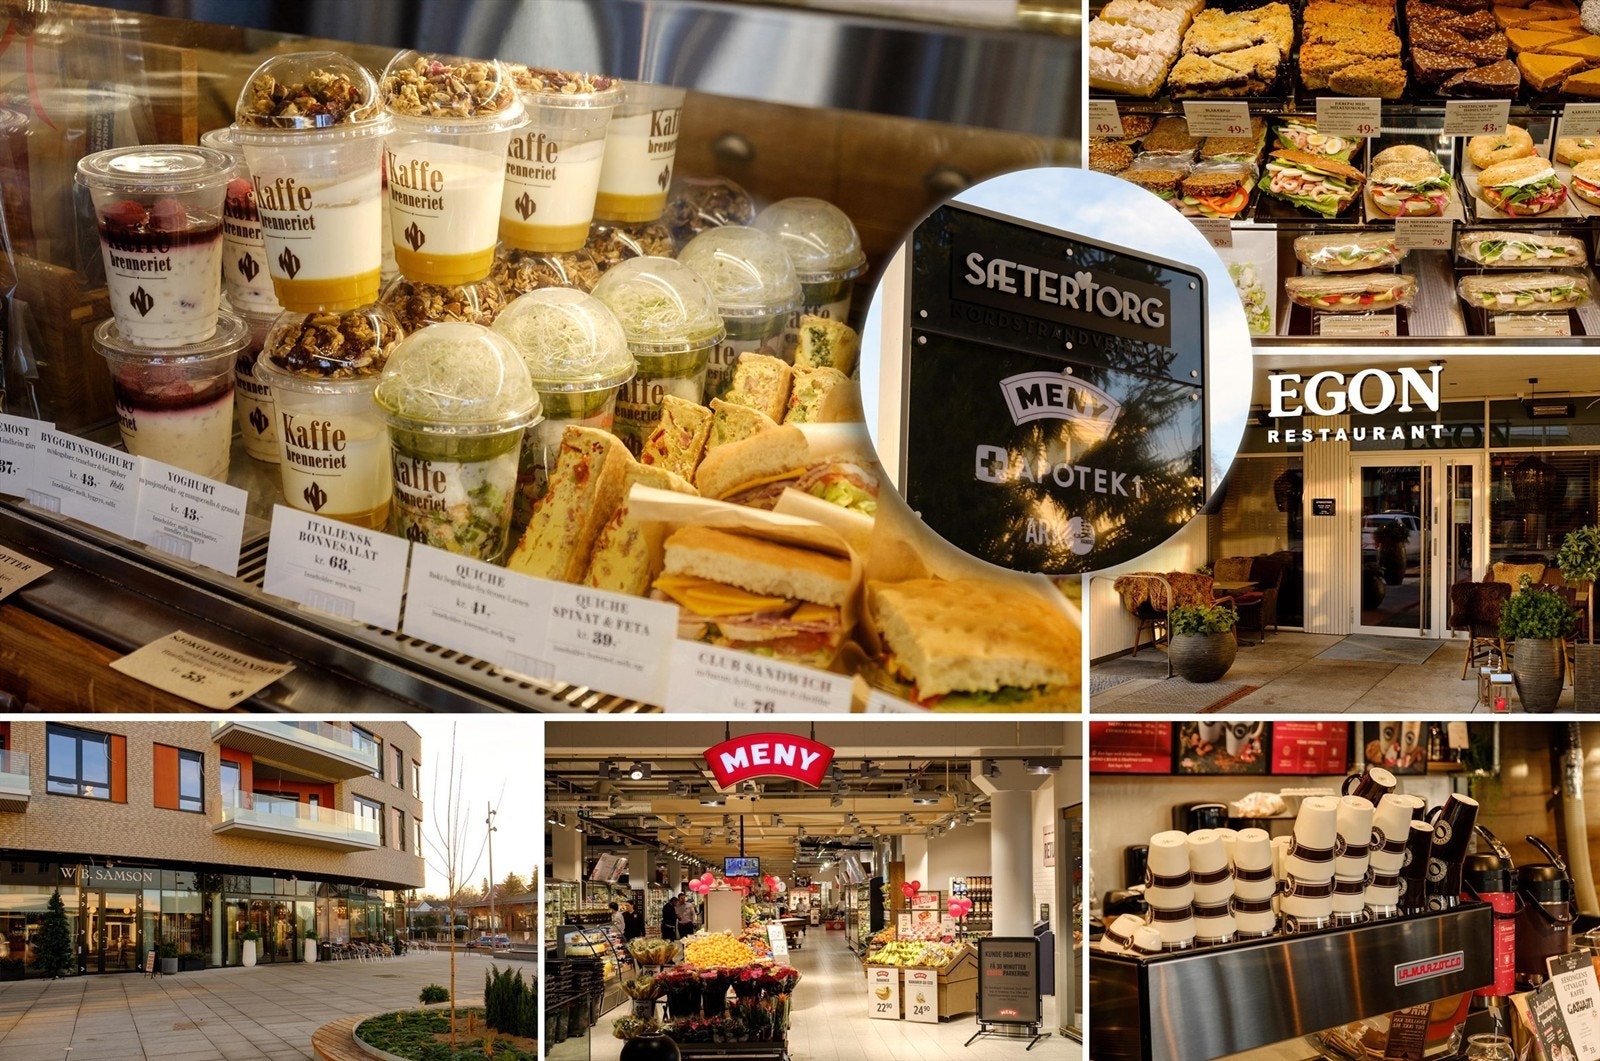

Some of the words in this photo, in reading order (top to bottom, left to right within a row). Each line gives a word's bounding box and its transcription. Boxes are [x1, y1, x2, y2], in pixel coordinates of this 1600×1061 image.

[1226, 125, 1249, 135] 49,-
[1356, 124, 1379, 134] 49,-
[1482, 123, 1502, 133] 43,-
[388, 150, 445, 194] Kaffe
[253, 174, 314, 212] Kaffe
[390, 191, 445, 212] brenneriet
[260, 209, 317, 233] brenneriet
[1213, 239, 1230, 247] 59,-
[1432, 238, 1448, 246] 79,-
[109, 251, 173, 272] brenneriet
[1015, 382, 1109, 421] MENY
[1267, 365, 1444, 418] EGON
[281, 411, 347, 452] Kaffe
[1267, 424, 1445, 443] RESTAURANT
[40, 431, 135, 472] BYGGRYNSYOGHURT
[285, 444, 347, 470] brenneriet
[69, 469, 79, 481] kr.
[80, 473, 101, 489] 43,-
[391, 447, 448, 494] Kaffe
[1016, 459, 1130, 499] APOTEK
[168, 472, 216, 496] YOGHURT
[170, 502, 180, 514] kr.
[182, 506, 204, 522] 43,-
[307, 519, 372, 548] ITALIENSK
[314, 554, 326, 566] kr.
[328, 555, 357, 574] 68,-
[456, 563, 506, 589] QUICHE
[575, 594, 629, 615] QUICHE
[551, 606, 600, 626] SPINAT
[603, 616, 612, 629] &
[616, 619, 650, 637] FETA
[169, 634, 285, 675] SJOKOLADEMANDLER
[698, 651, 741, 671] CLUB
[744, 662, 832, 693] SANDWICH
[719, 743, 821, 774] MENY
[95, 869, 153, 882] SAMSON
[1014, 951, 1032, 959] MENY?
